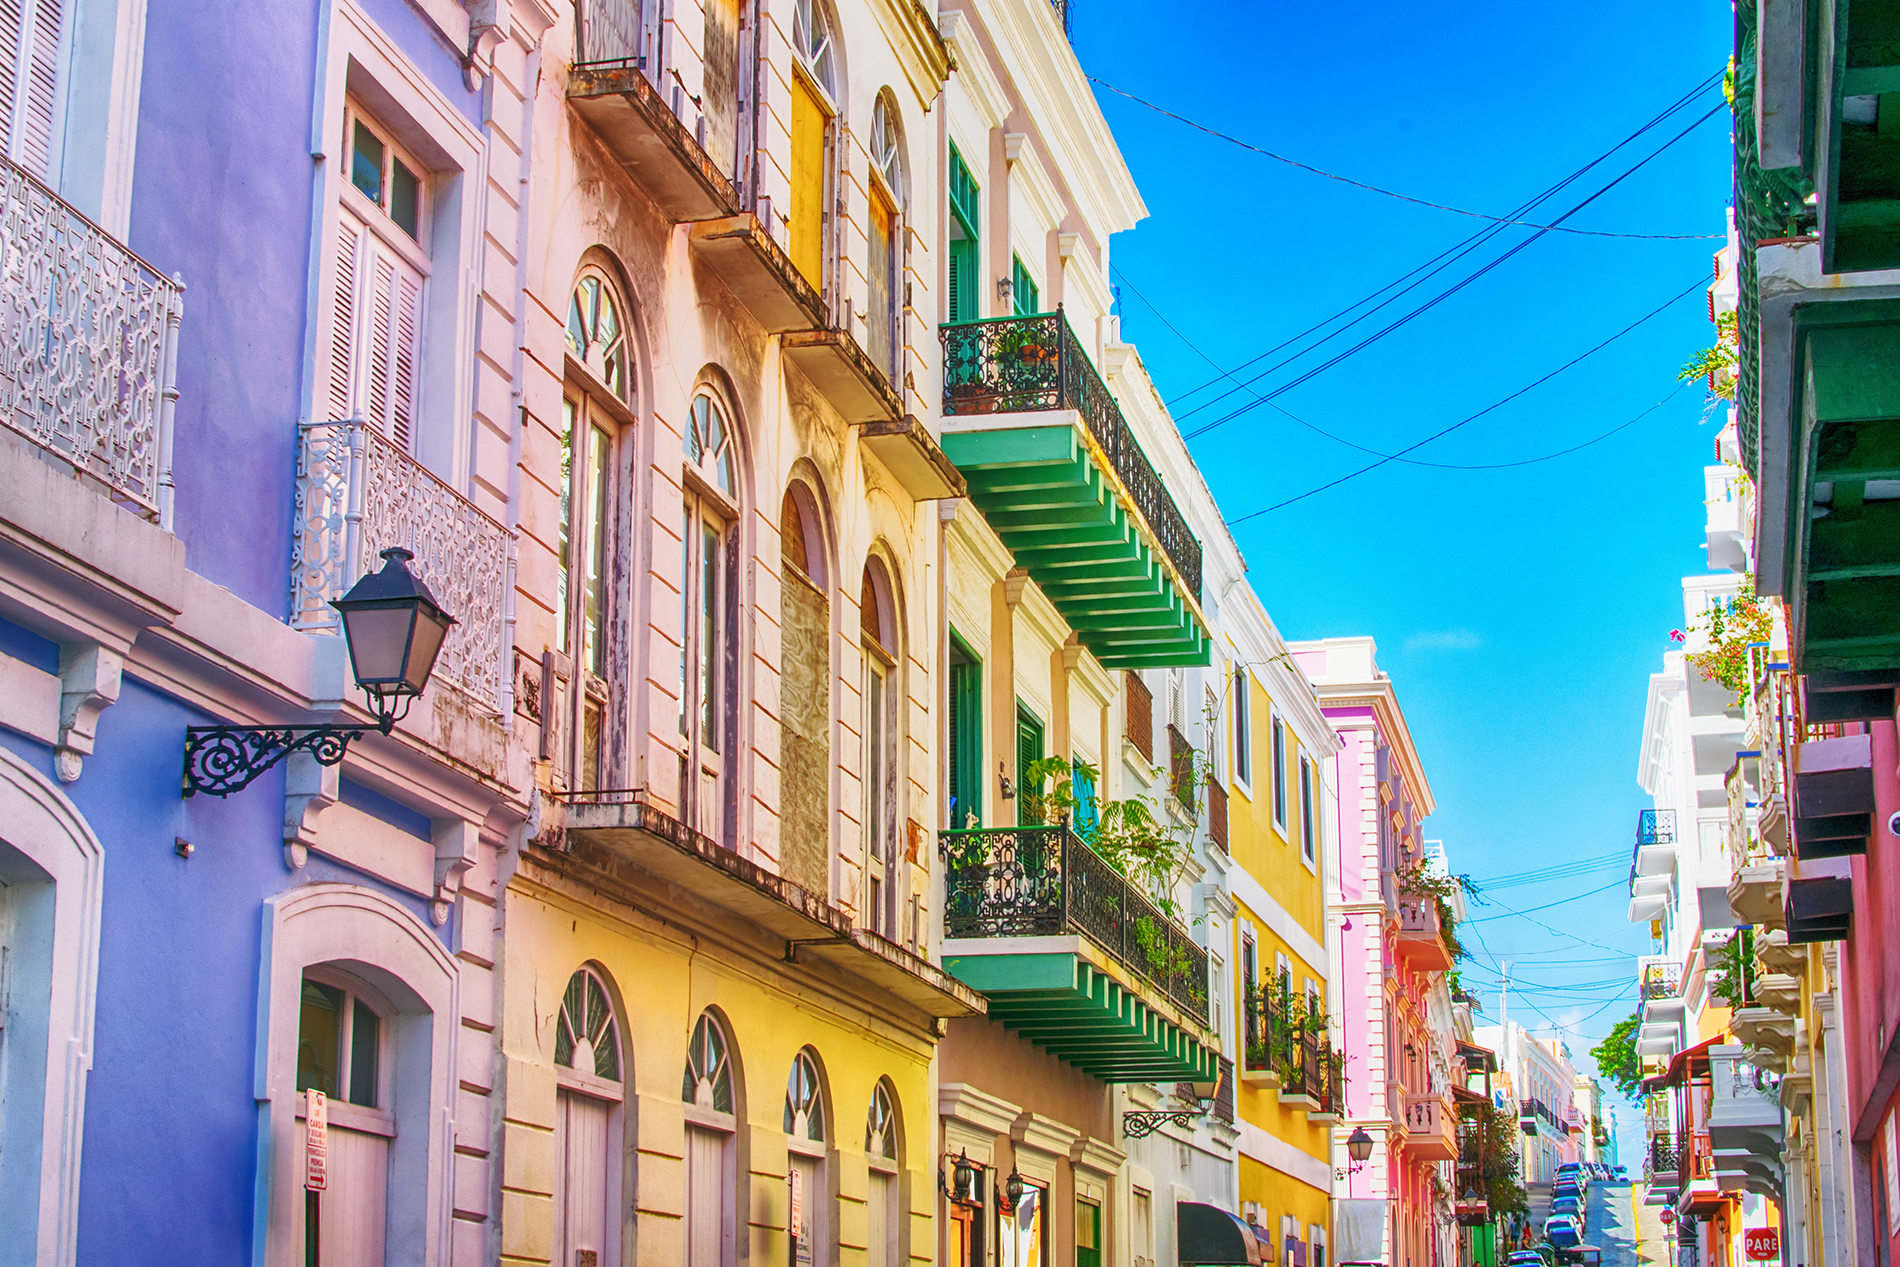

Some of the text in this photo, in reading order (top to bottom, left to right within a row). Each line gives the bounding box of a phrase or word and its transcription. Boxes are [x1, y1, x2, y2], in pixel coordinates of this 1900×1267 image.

[310, 1119, 324, 1129] CARGA
[311, 1158, 323, 1167] PRENSA
[1746, 1238, 1777, 1250] PARE
